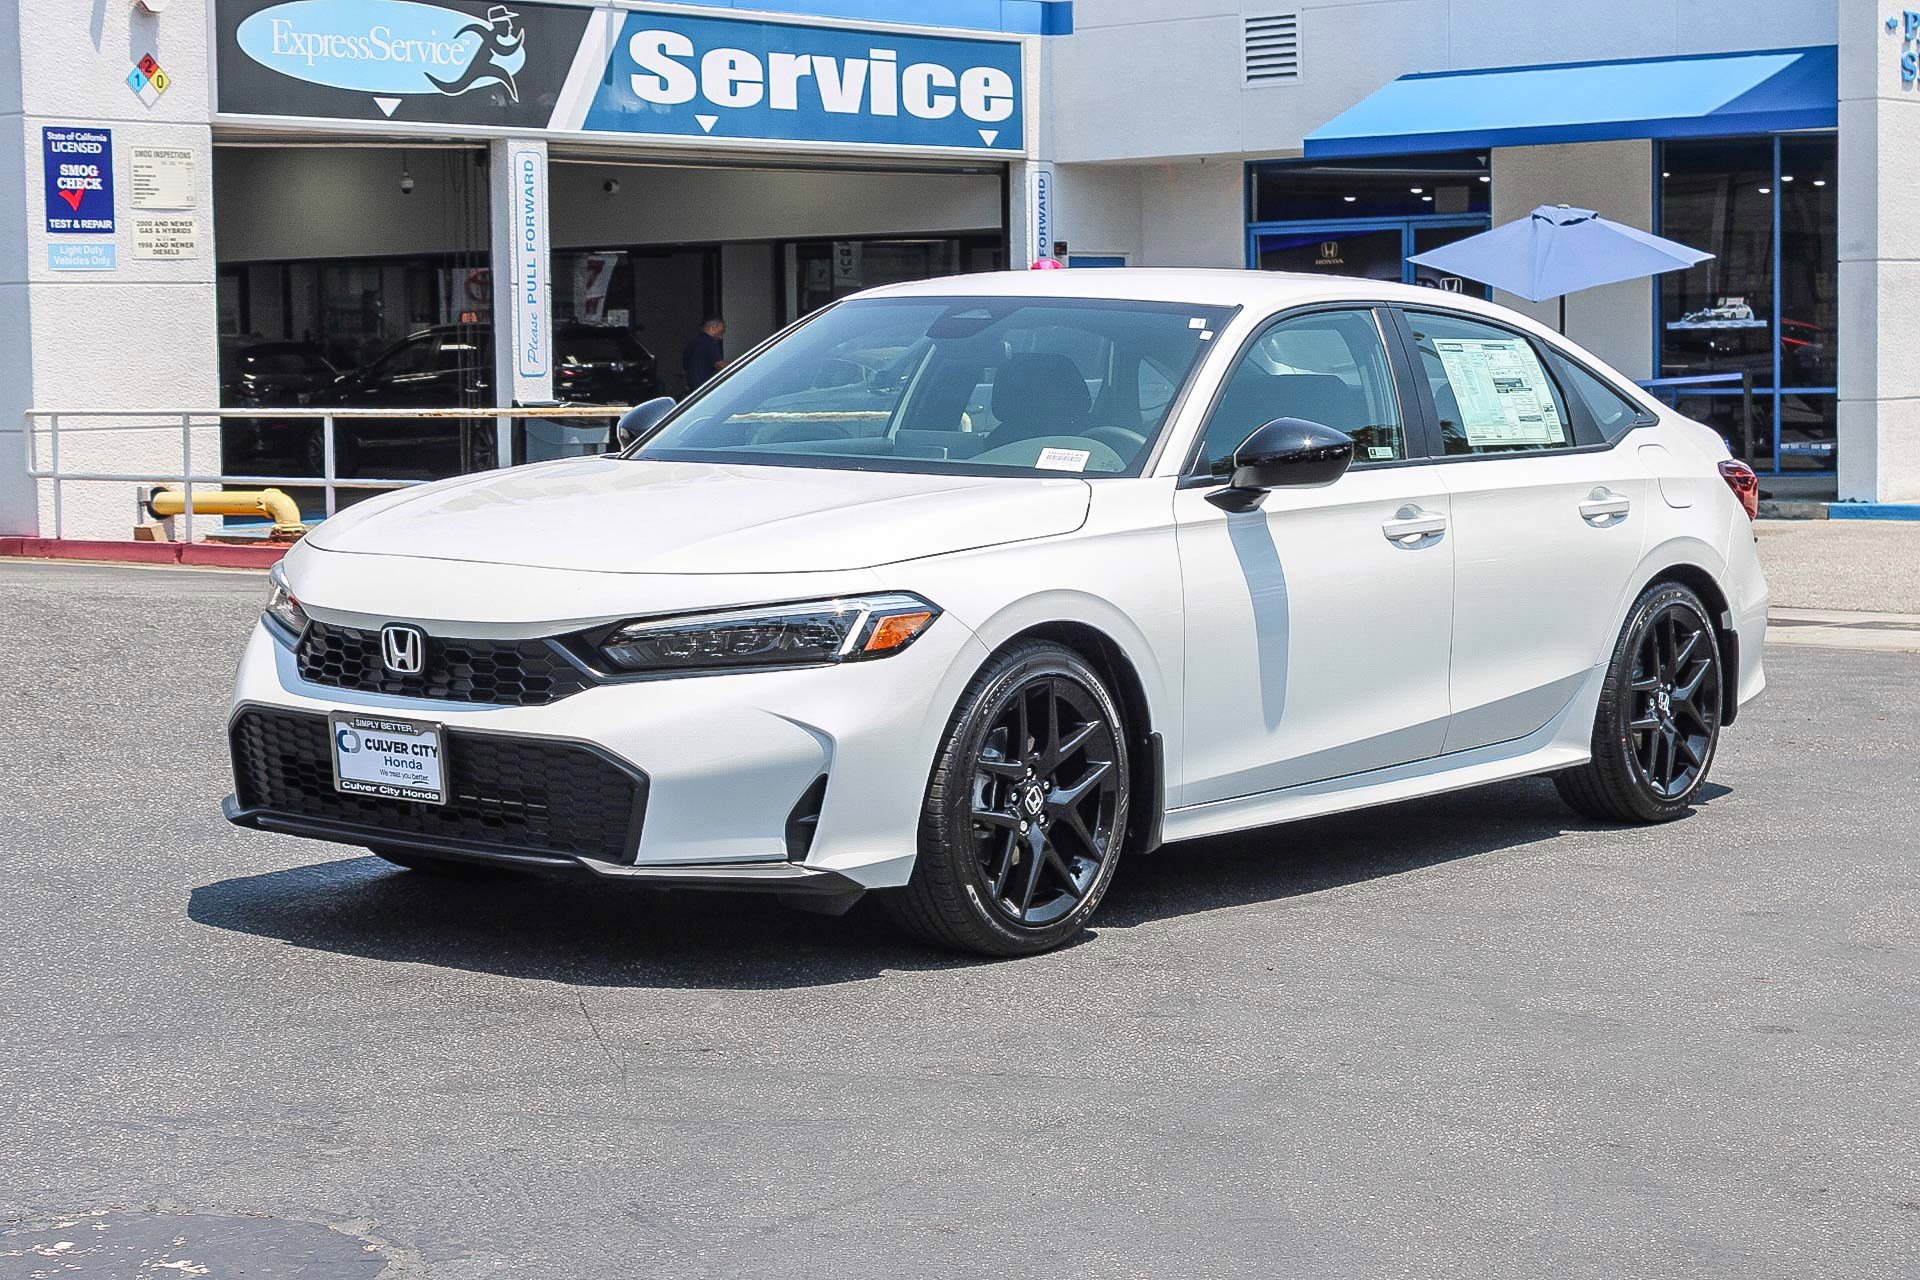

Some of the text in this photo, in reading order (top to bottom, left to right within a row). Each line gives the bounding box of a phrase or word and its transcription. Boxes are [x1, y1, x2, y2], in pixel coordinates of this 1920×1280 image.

[144, 58, 152, 73] 2
[135, 73, 140, 87] 1
[156, 74, 164, 88] 0
[629, 29, 1014, 122] Service
[46, 131, 107, 142] State of California
[51, 141, 102, 153] LICENSED
[134, 150, 191, 159] SMOG INSPECTIONS
[60, 164, 98, 177] SMOG
[57, 177, 103, 190] CHECK
[49, 219, 113, 229] TEST & REPAIR
[1038, 178, 1047, 257] FORWARD
[60, 245, 104, 256] Light Duty
[53, 255, 110, 267] Vehicles Only
[523, 160, 538, 364] Please PULL FORWARD
[355, 719, 413, 732] SIMPLY BETTER
[364, 738, 438, 758] CULVER CITY
[384, 756, 423, 770] Honda
[380, 769, 389, 777] We
[389, 770, 401, 778] treat
[402, 771, 411, 780] you
[342, 781, 439, 800] Culver City Honda
